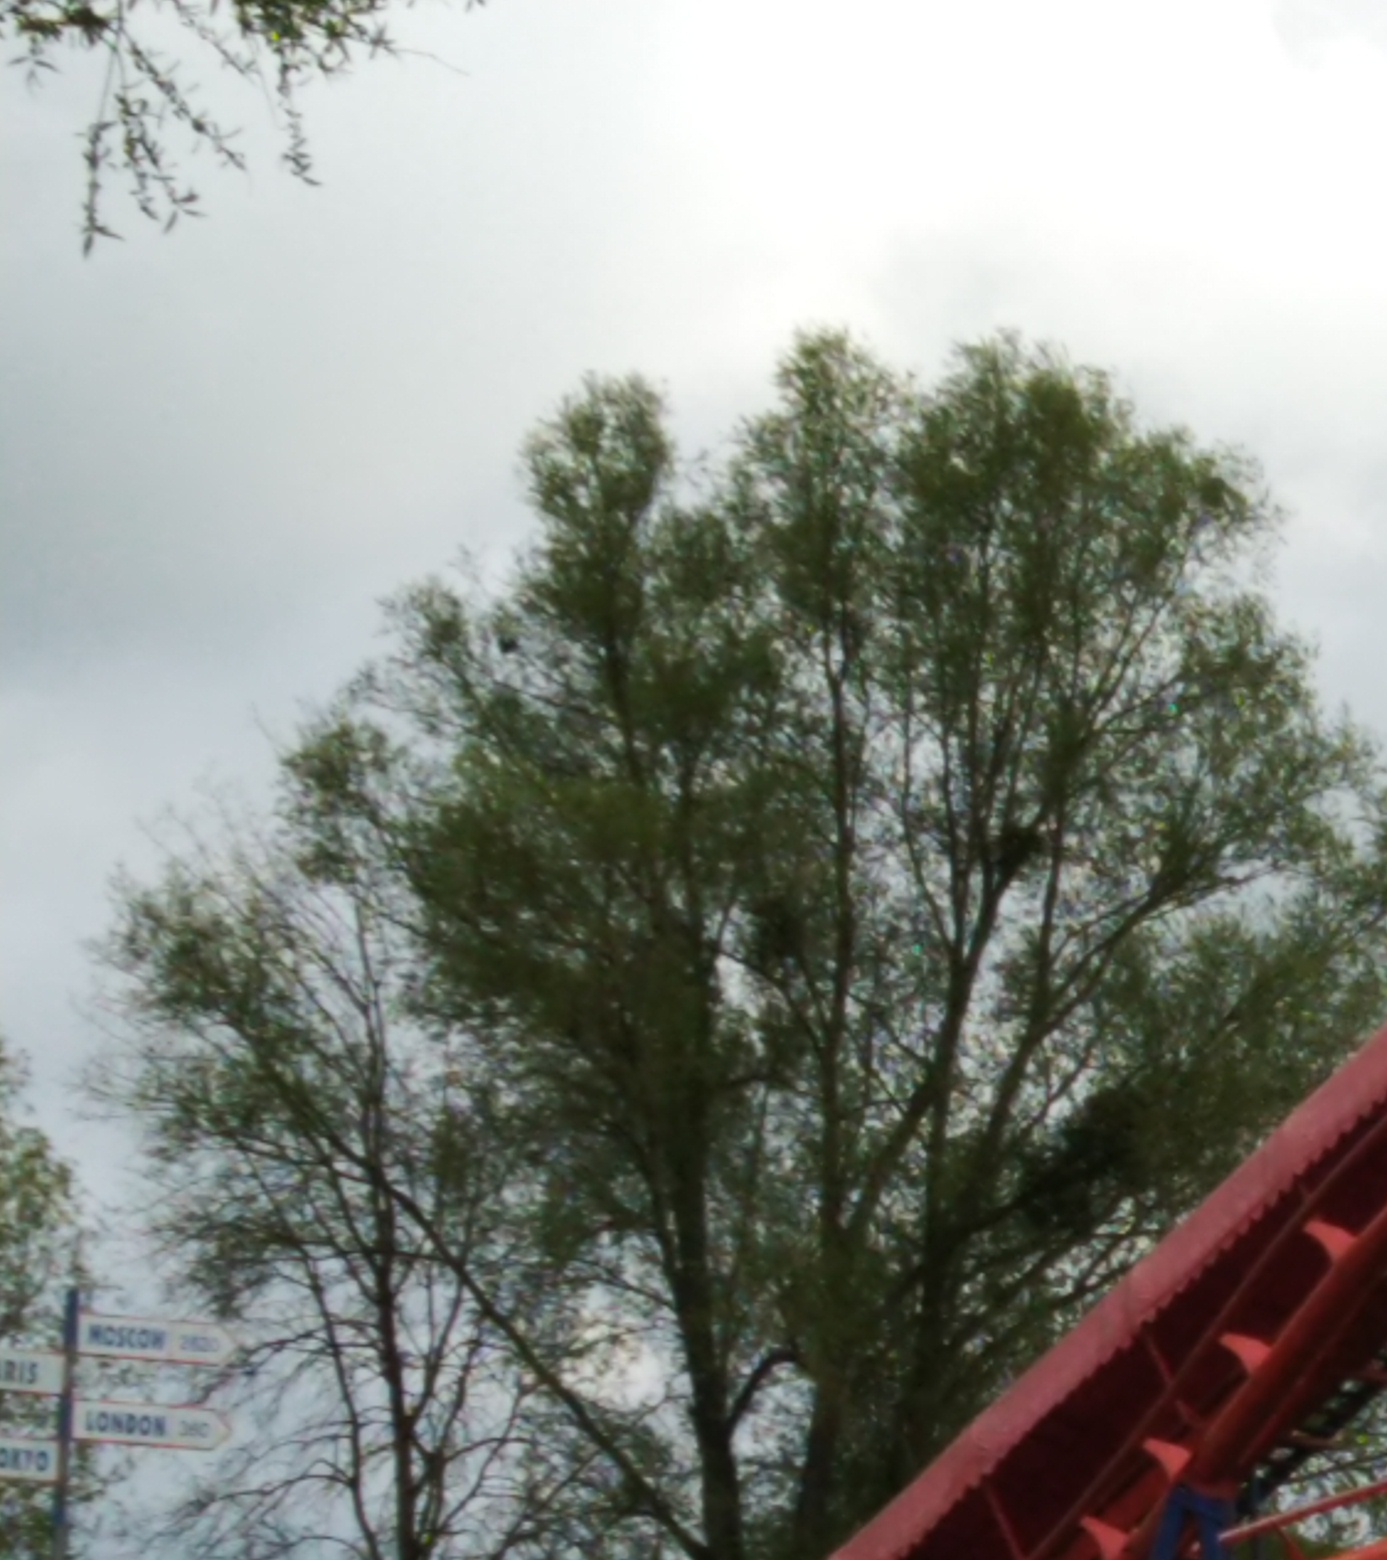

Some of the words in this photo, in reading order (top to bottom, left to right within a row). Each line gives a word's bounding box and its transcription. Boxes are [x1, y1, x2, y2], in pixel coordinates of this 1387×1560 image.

[88, 1324, 167, 1350] MOSCOW
[0, 1358, 38, 1385] RIS
[85, 1410, 167, 1436] LONDON
